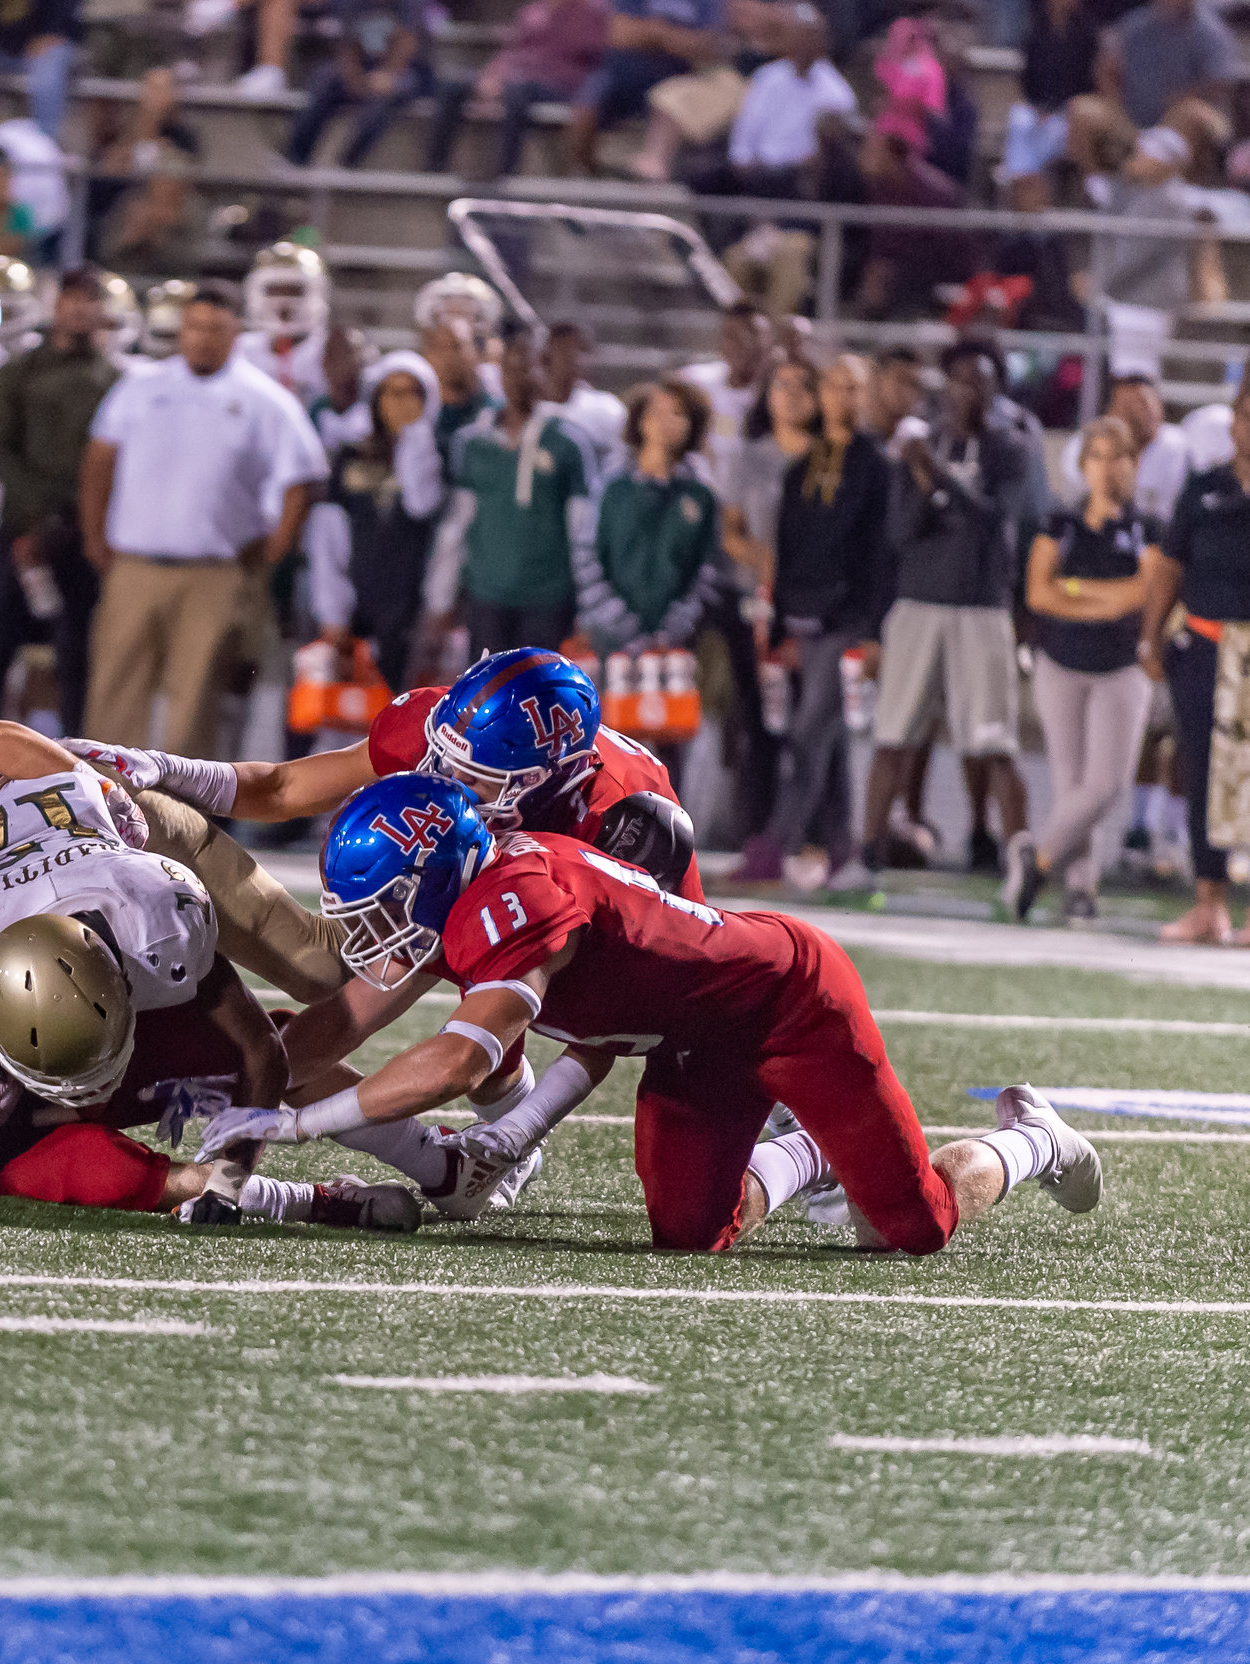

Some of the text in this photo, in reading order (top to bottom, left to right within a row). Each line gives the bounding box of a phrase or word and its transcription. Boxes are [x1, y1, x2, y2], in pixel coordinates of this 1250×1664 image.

[440, 725, 469, 752] Riddell
[519, 696, 585, 760] LA
[368, 801, 454, 857] LA
[479, 891, 529, 947] 13
